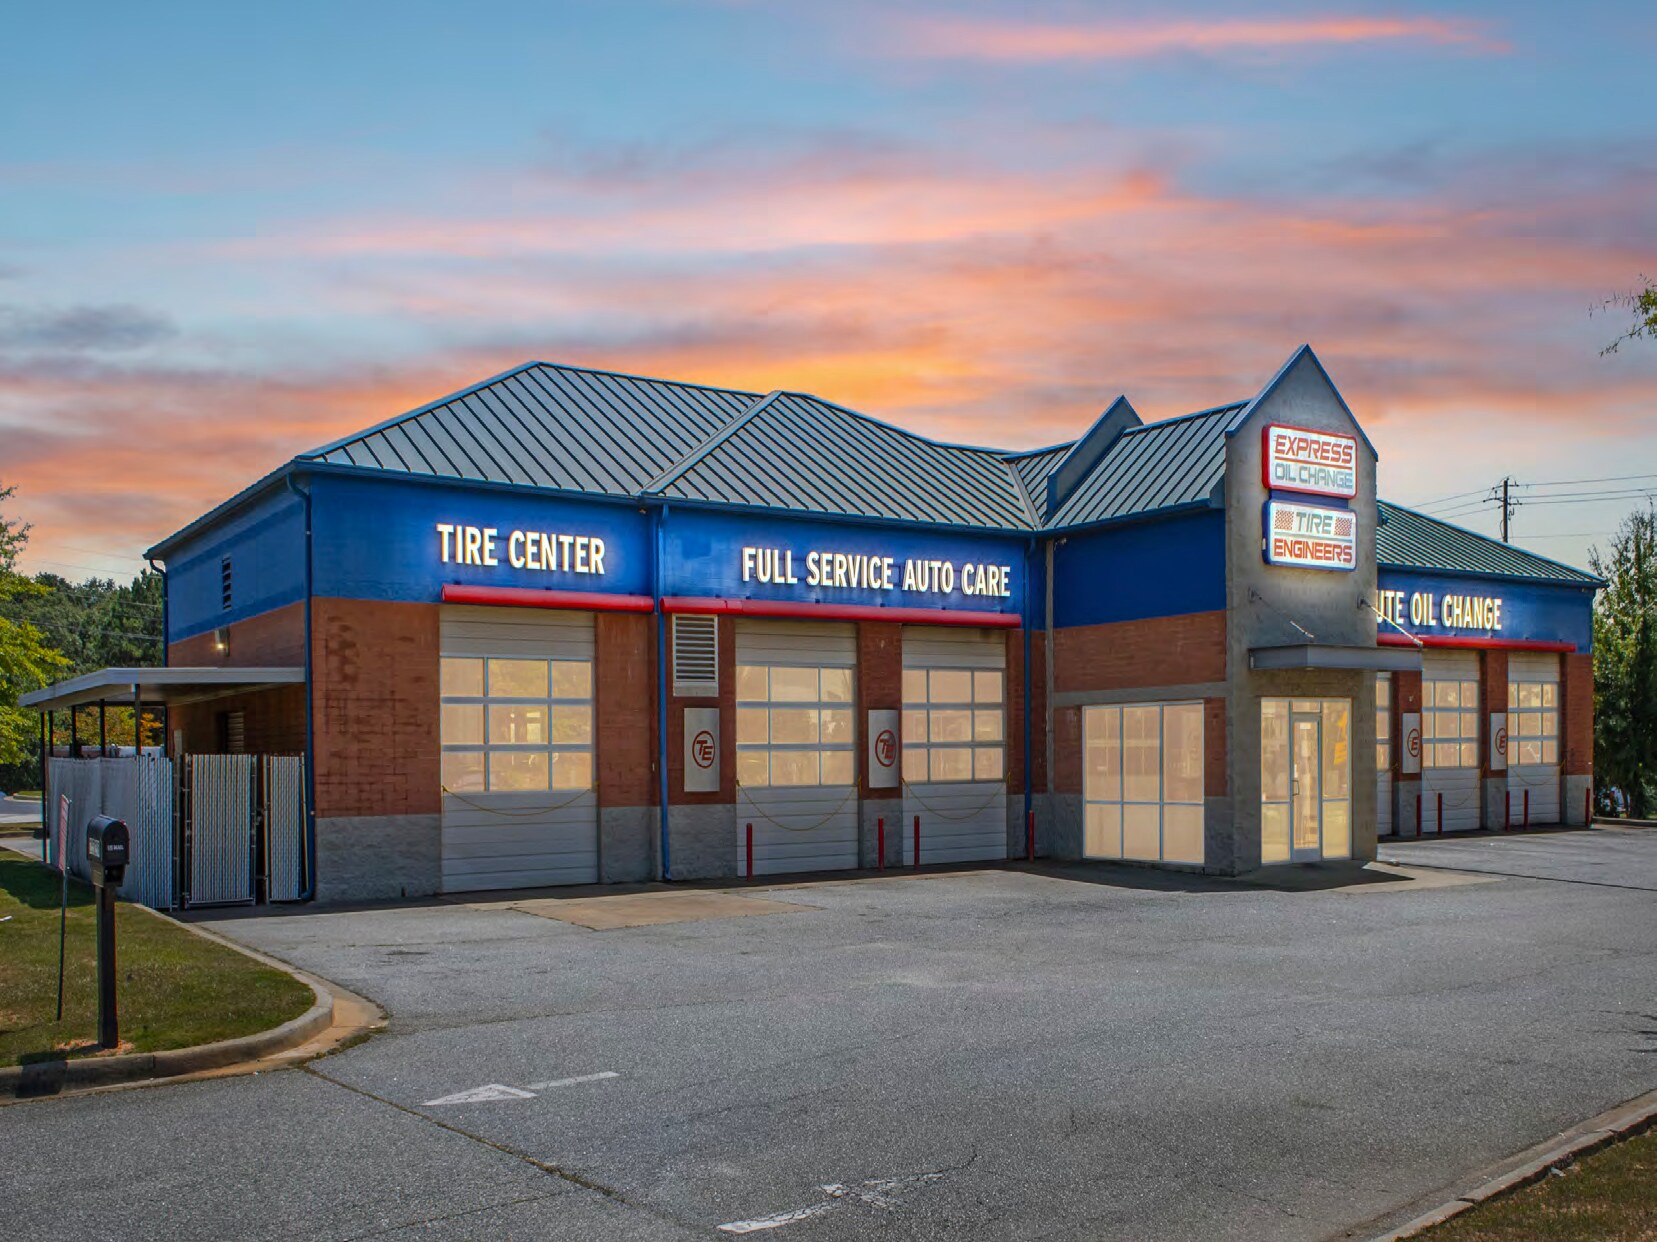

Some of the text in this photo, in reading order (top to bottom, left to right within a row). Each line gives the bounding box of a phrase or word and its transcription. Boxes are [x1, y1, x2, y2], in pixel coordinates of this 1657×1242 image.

[1274, 434, 1353, 464] EXPRESS
[1275, 463, 1353, 490] OIL CHANGE
[1296, 511, 1333, 535] TIRE
[436, 523, 605, 575] TIRE CENTER
[1274, 538, 1352, 564] ENGINEERS
[742, 547, 1011, 597] FULL SERVICE AUTO CARE
[1410, 592, 1436, 626] OIL
[1441, 595, 1502, 630] CHANGE
[696, 739, 713, 761] TE
